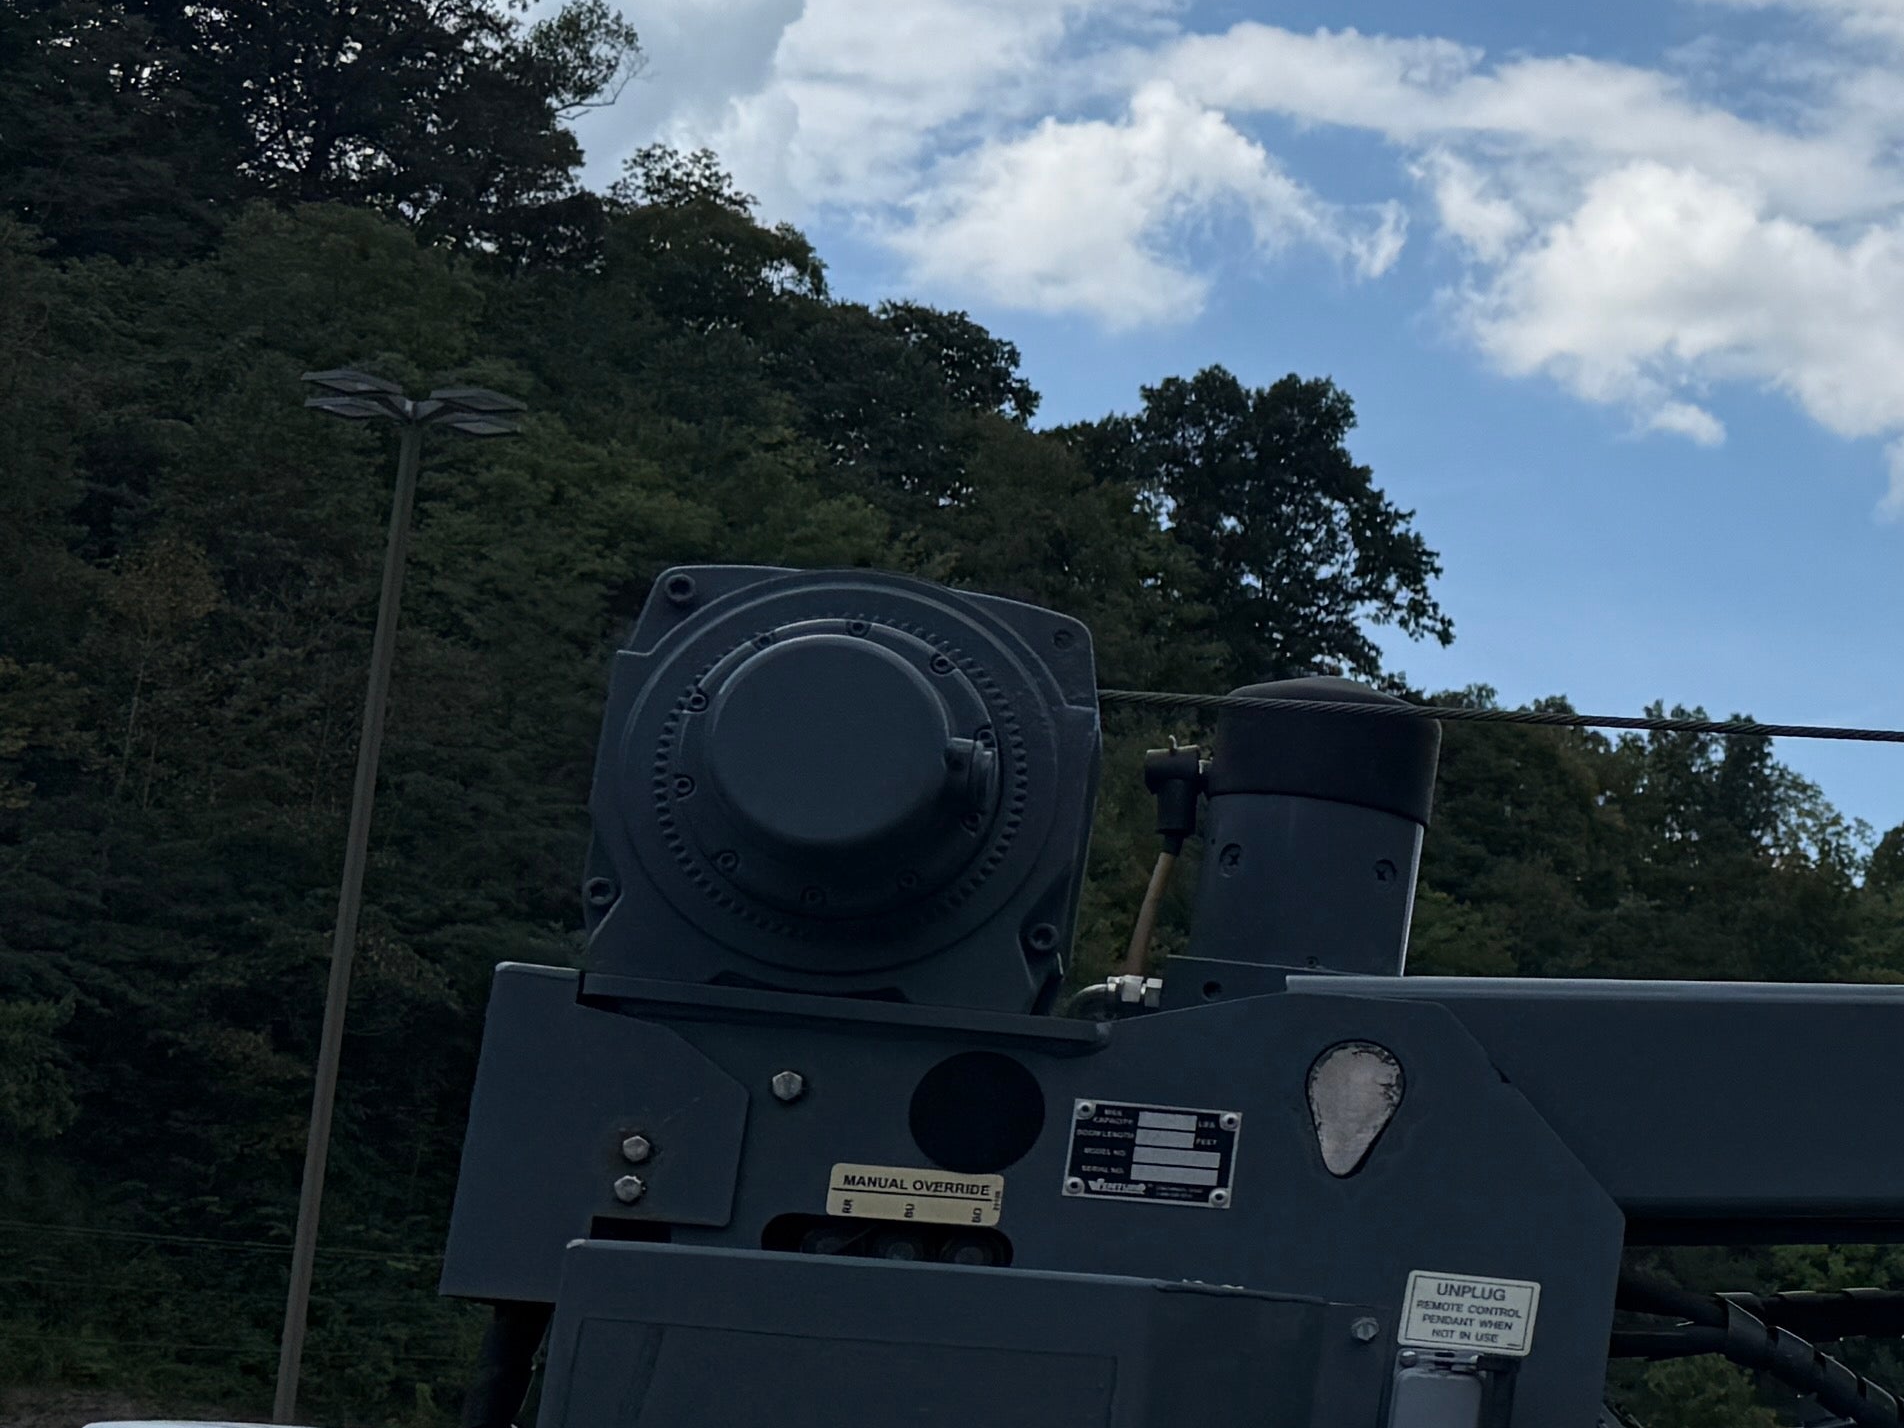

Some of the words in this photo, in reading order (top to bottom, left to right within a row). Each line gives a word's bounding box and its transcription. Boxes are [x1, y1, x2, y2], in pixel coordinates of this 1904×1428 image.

[843, 1174, 908, 1190] MANUAL
[912, 1179, 990, 1196] OVERRIDE
[1436, 1283, 1506, 1301] UNPLUG
[1416, 1300, 1463, 1313] REMOTE
[1468, 1304, 1522, 1319] CONTROL
[1422, 1314, 1475, 1327] PENDANT
[1479, 1319, 1513, 1330] WHEN
[1432, 1329, 1455, 1339] NOT
[1459, 1331, 1471, 1341] IN
[1475, 1333, 1500, 1343] USE
